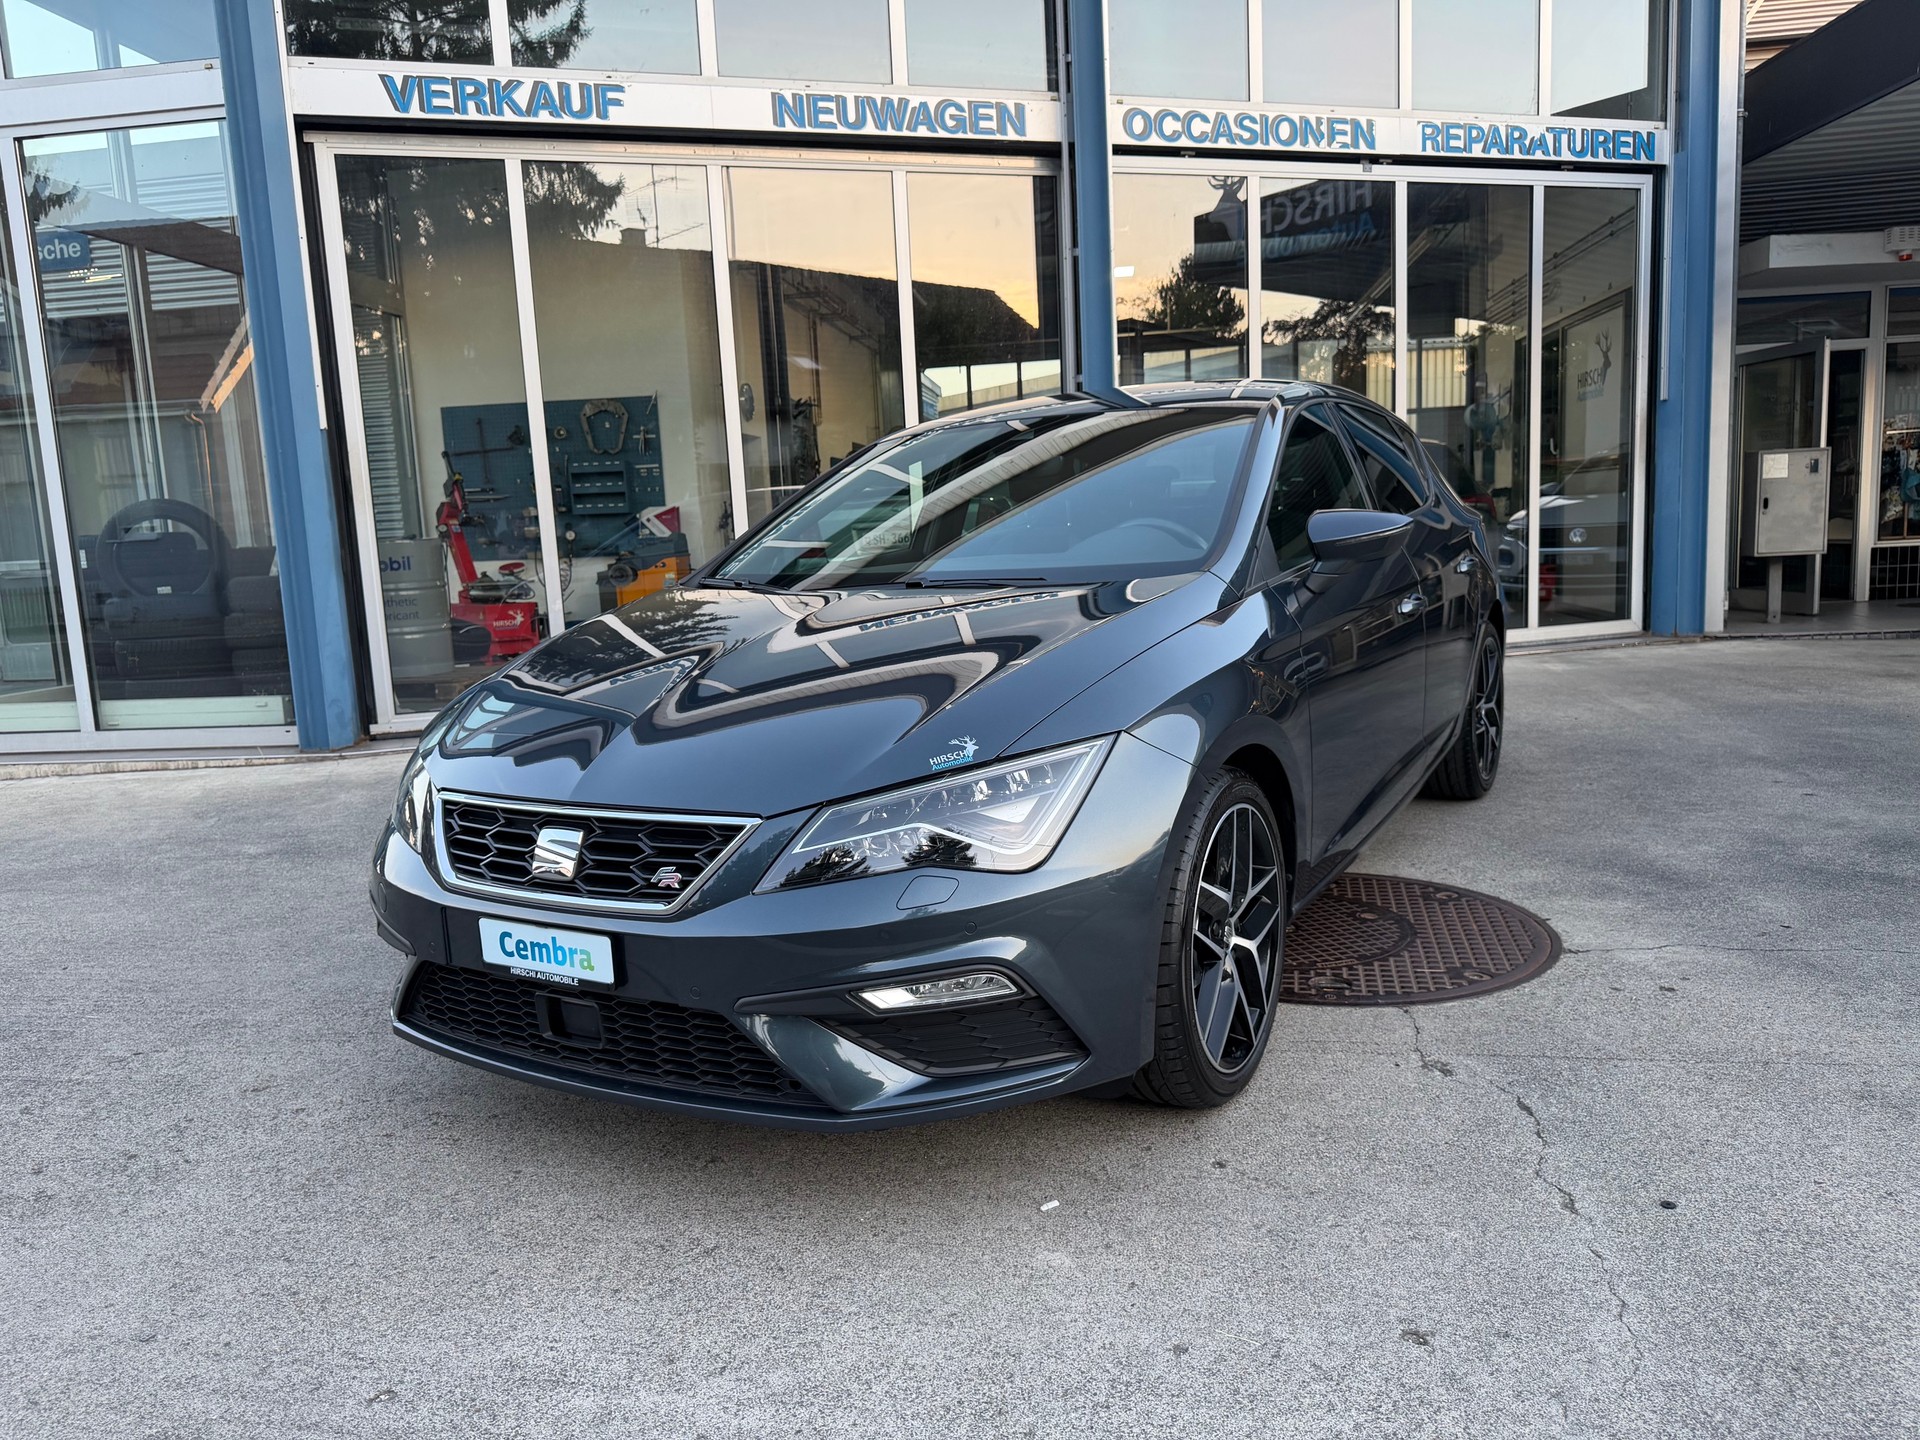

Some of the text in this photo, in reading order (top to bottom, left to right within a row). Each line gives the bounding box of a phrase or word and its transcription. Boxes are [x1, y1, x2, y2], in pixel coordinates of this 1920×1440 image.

[378, 74, 626, 121] VERKAUF
[771, 91, 1027, 137] NEUWAGEN
[1122, 107, 1377, 150] OCCASIONEN
[1417, 120, 1656, 161] REPARATUREN
[931, 756, 973, 771] Automobile
[650, 866, 682, 889] FR
[499, 931, 595, 972] Cembra
[510, 967, 579, 986] HIRSCHI AUTOMOBILE
